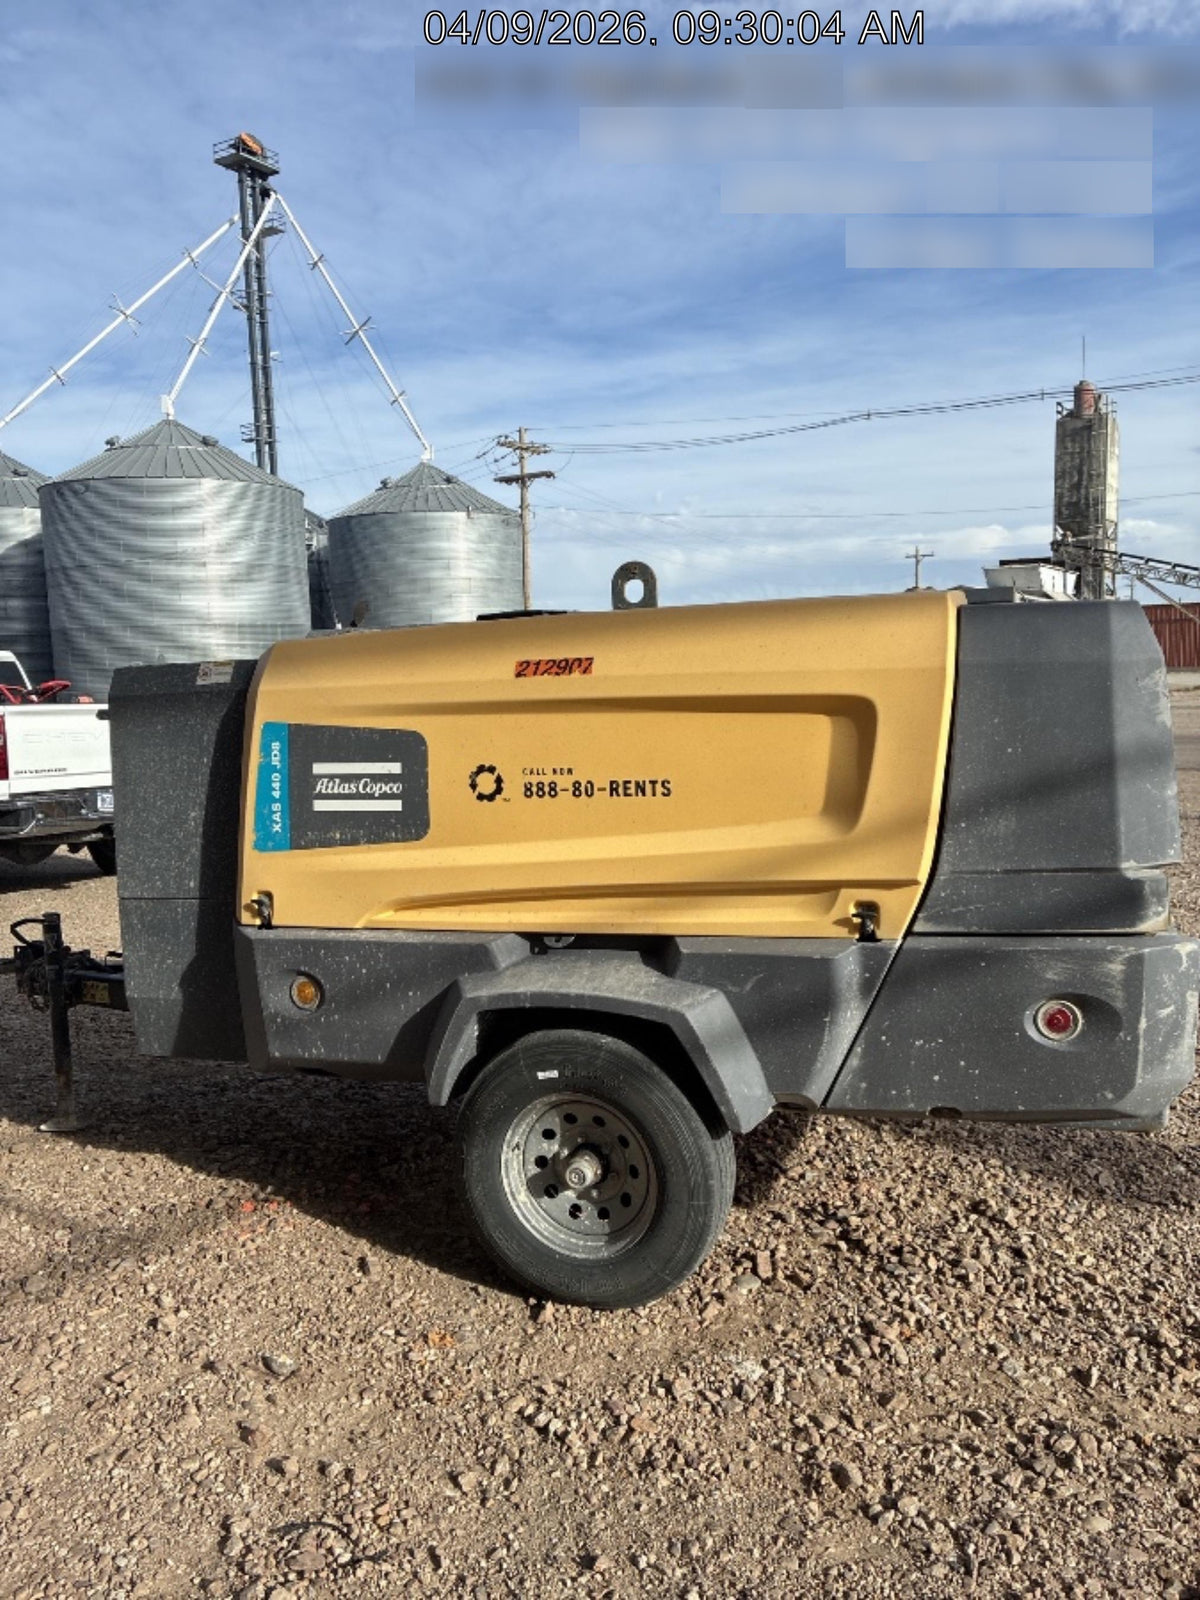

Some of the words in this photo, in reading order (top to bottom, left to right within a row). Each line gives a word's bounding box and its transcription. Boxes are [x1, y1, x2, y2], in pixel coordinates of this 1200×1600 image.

[522, 767, 547, 776] CALL
[552, 767, 574, 776] NOW
[271, 773, 282, 799] 440
[314, 778, 357, 794] Atlas
[358, 777, 402, 797] Copco
[523, 780, 672, 798] 888-80-RENTS
[271, 803, 282, 833] XAS
